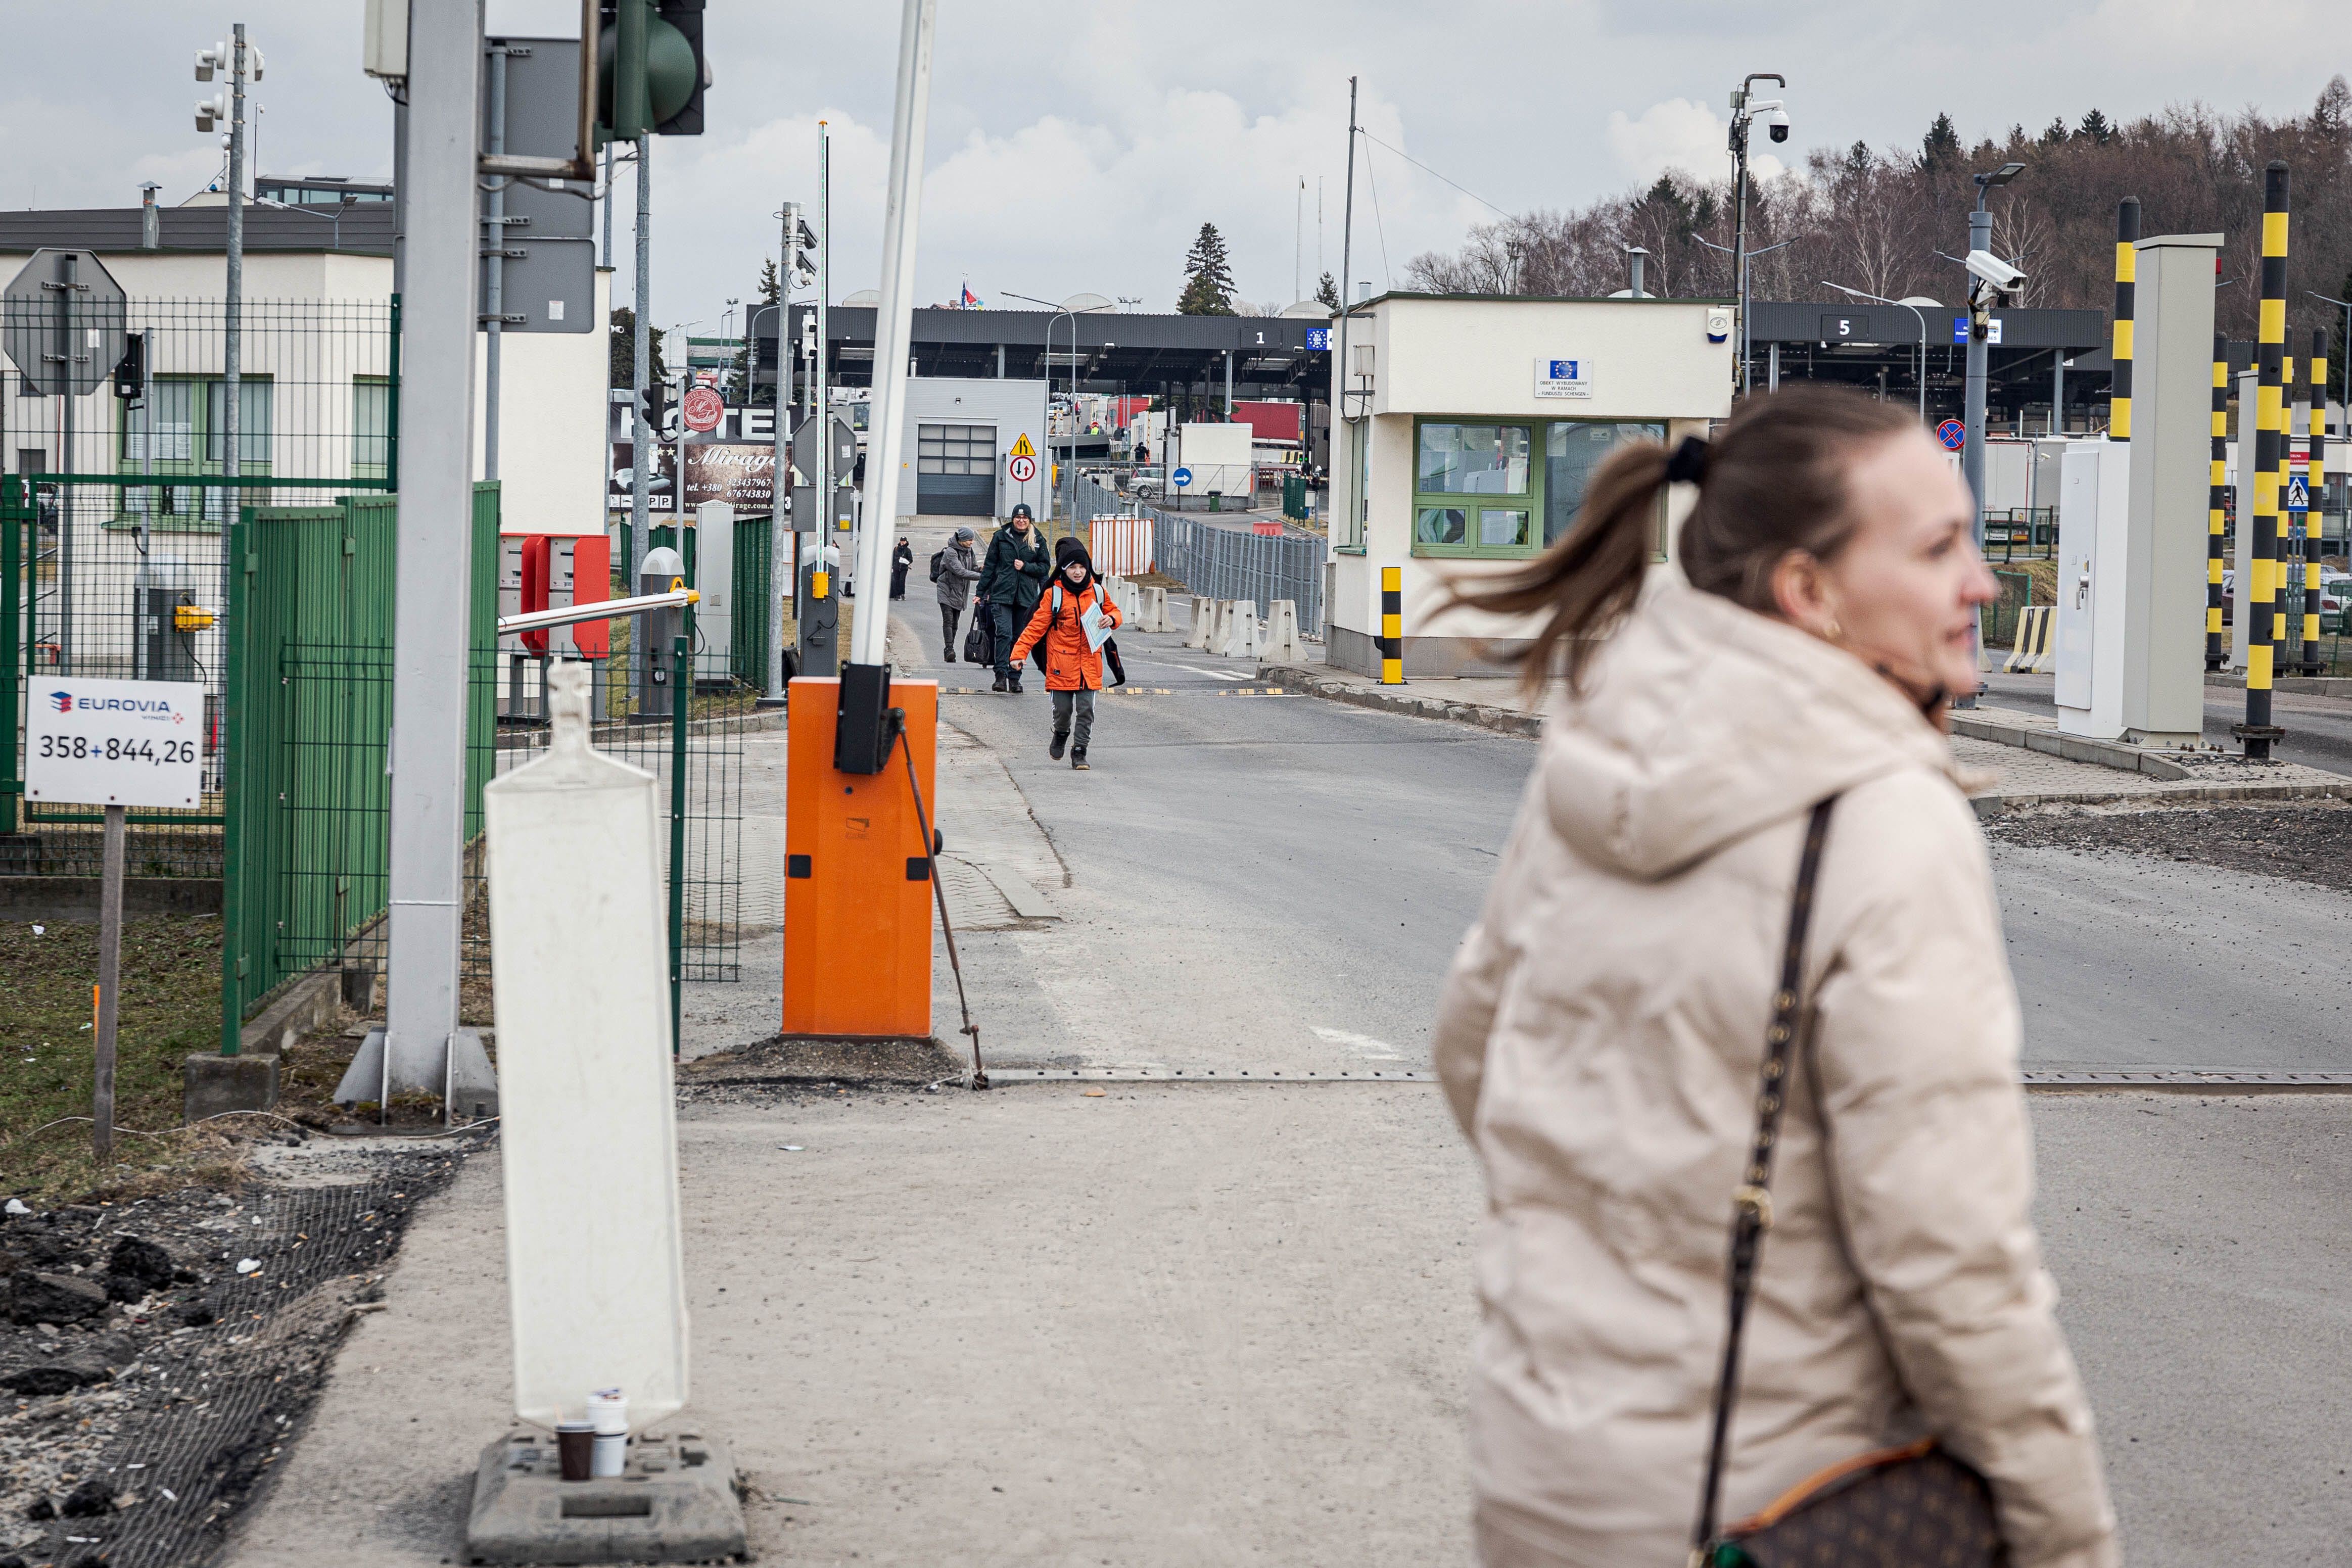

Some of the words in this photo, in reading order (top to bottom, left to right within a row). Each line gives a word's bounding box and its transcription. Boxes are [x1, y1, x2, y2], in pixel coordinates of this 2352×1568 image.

[1840, 320, 1850, 336] 5
[1256, 331, 1265, 344] 1
[684, 392, 700, 406] HOTEL
[701, 392, 720, 406] MIRAGE
[686, 483, 699, 491] tel.
[701, 483, 722, 492] +380
[726, 478, 772, 487] 323437967
[726, 490, 771, 498] 676743830
[662, 497, 669, 506] P
[78, 698, 171, 712] EUROVIA
[40, 735, 195, 766] 358+844,26
